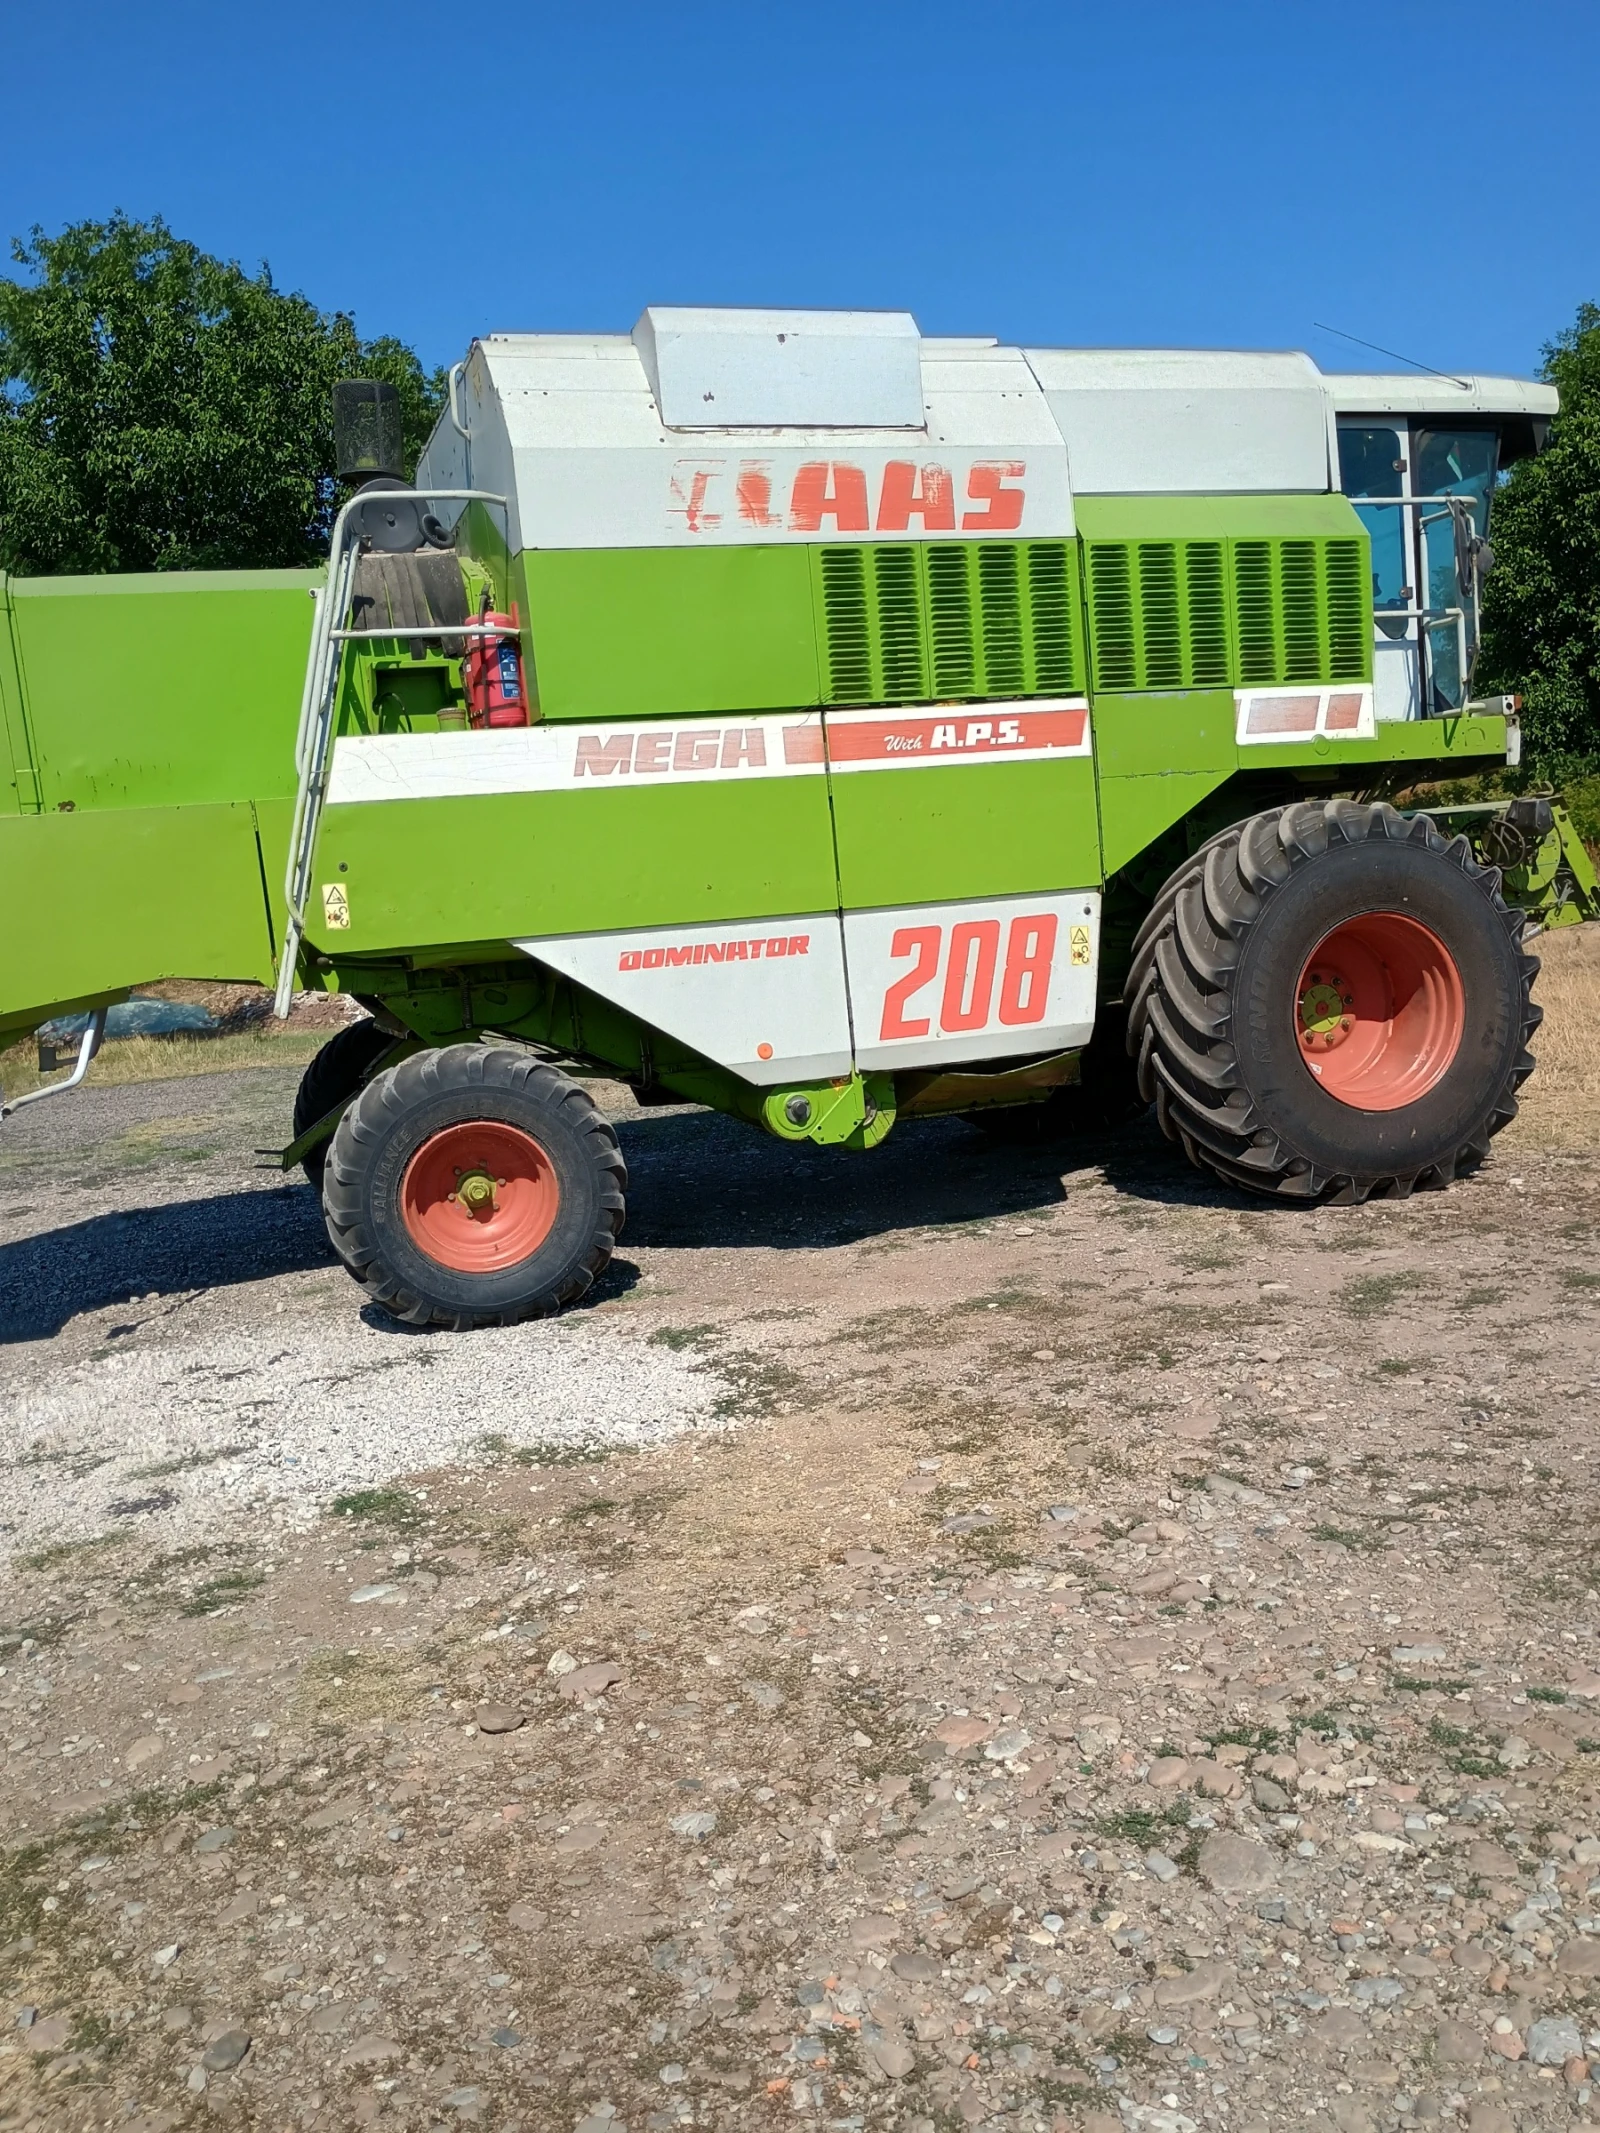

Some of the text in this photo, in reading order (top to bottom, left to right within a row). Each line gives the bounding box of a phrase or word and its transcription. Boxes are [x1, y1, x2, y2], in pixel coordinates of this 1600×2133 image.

[573, 727, 767, 778] MEGA
[884, 719, 1026, 752] With A.P.S.
[618, 934, 810, 972] DOMINATOR
[878, 913, 1059, 1042] 208
[373, 1129, 413, 1210] ALLIANCE
